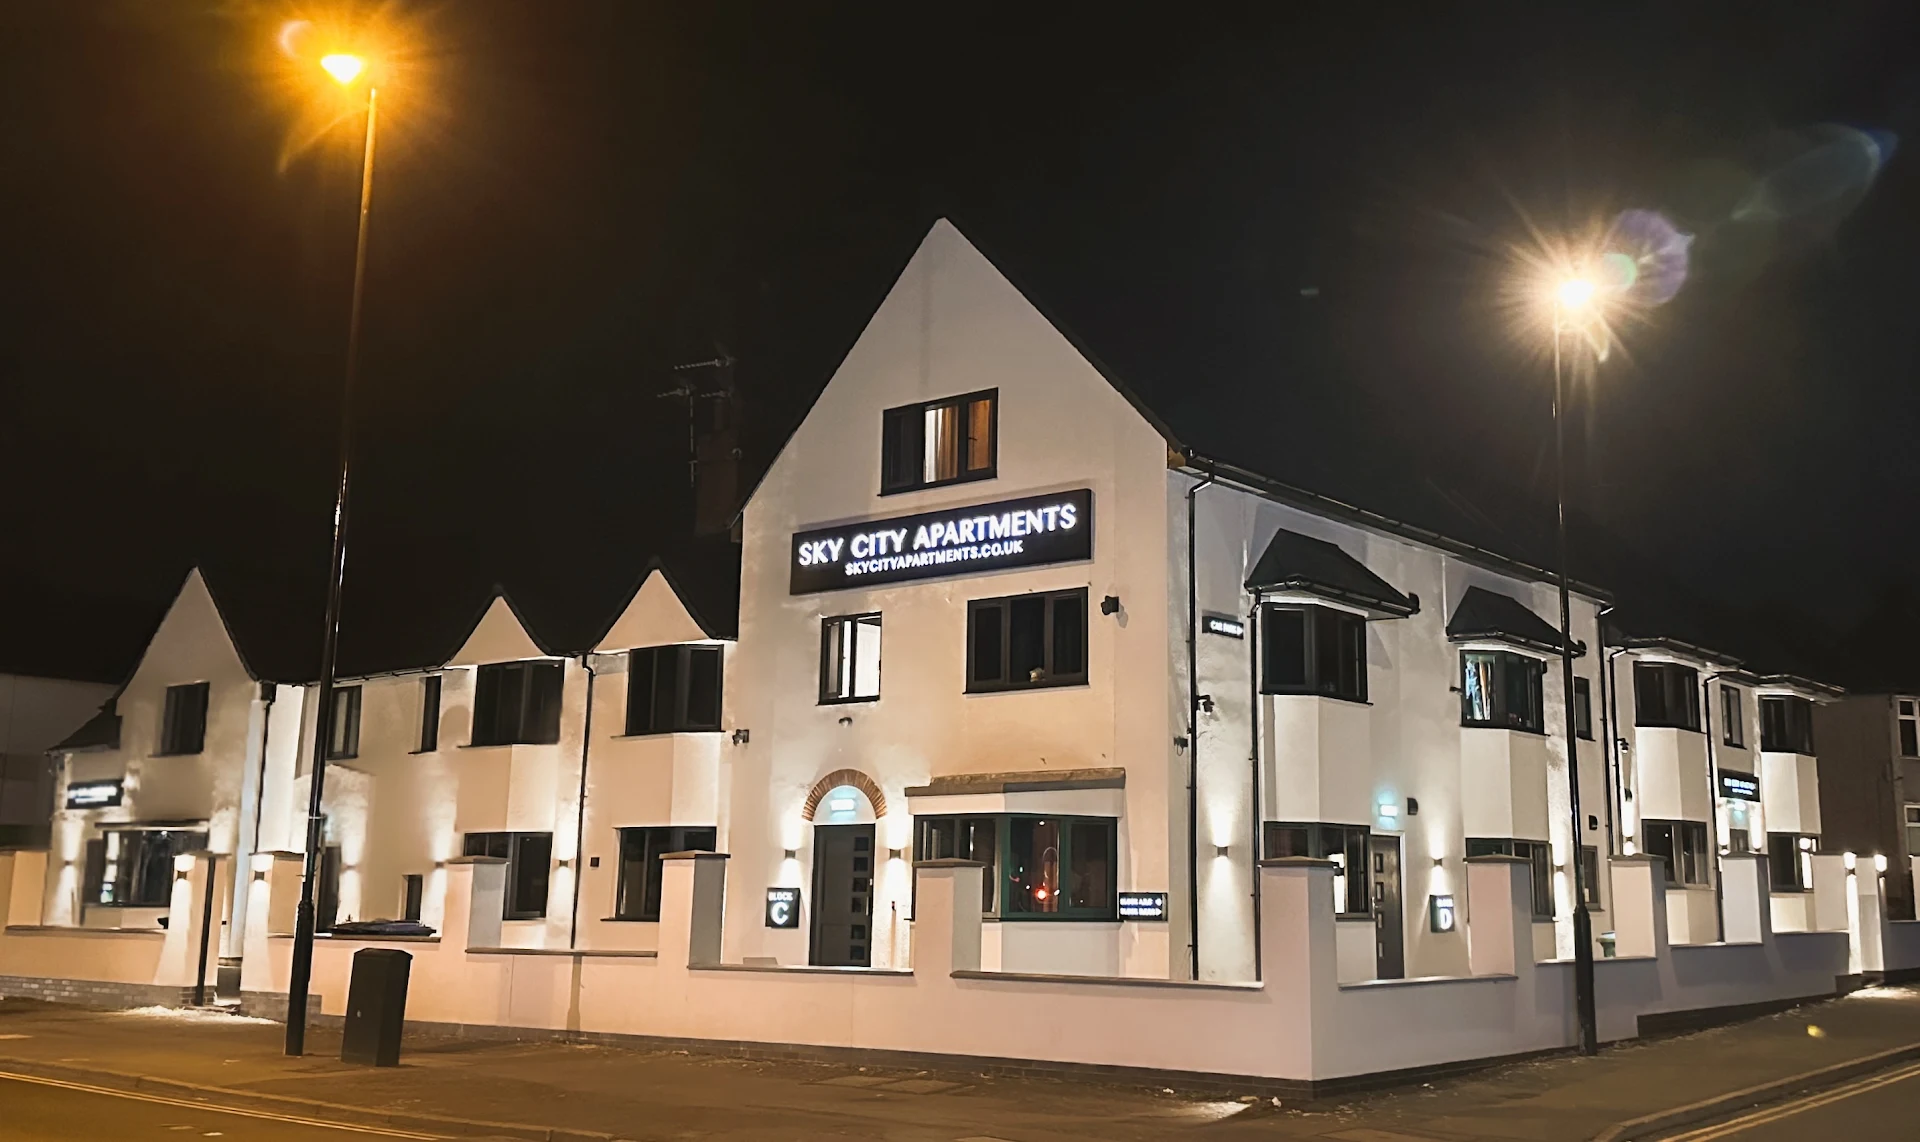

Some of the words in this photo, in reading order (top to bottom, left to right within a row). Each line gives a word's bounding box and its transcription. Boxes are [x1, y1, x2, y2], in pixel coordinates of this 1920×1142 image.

[798, 537, 845, 566] SKY
[850, 527, 908, 559] CITY
[912, 502, 1078, 551] APARTMENTS
[844, 539, 1024, 576] SKYCITYAPARTMENTS.CO.UK
[767, 891, 794, 902] BLOCK
[770, 901, 790, 926] C
[1439, 908, 1452, 930] D
